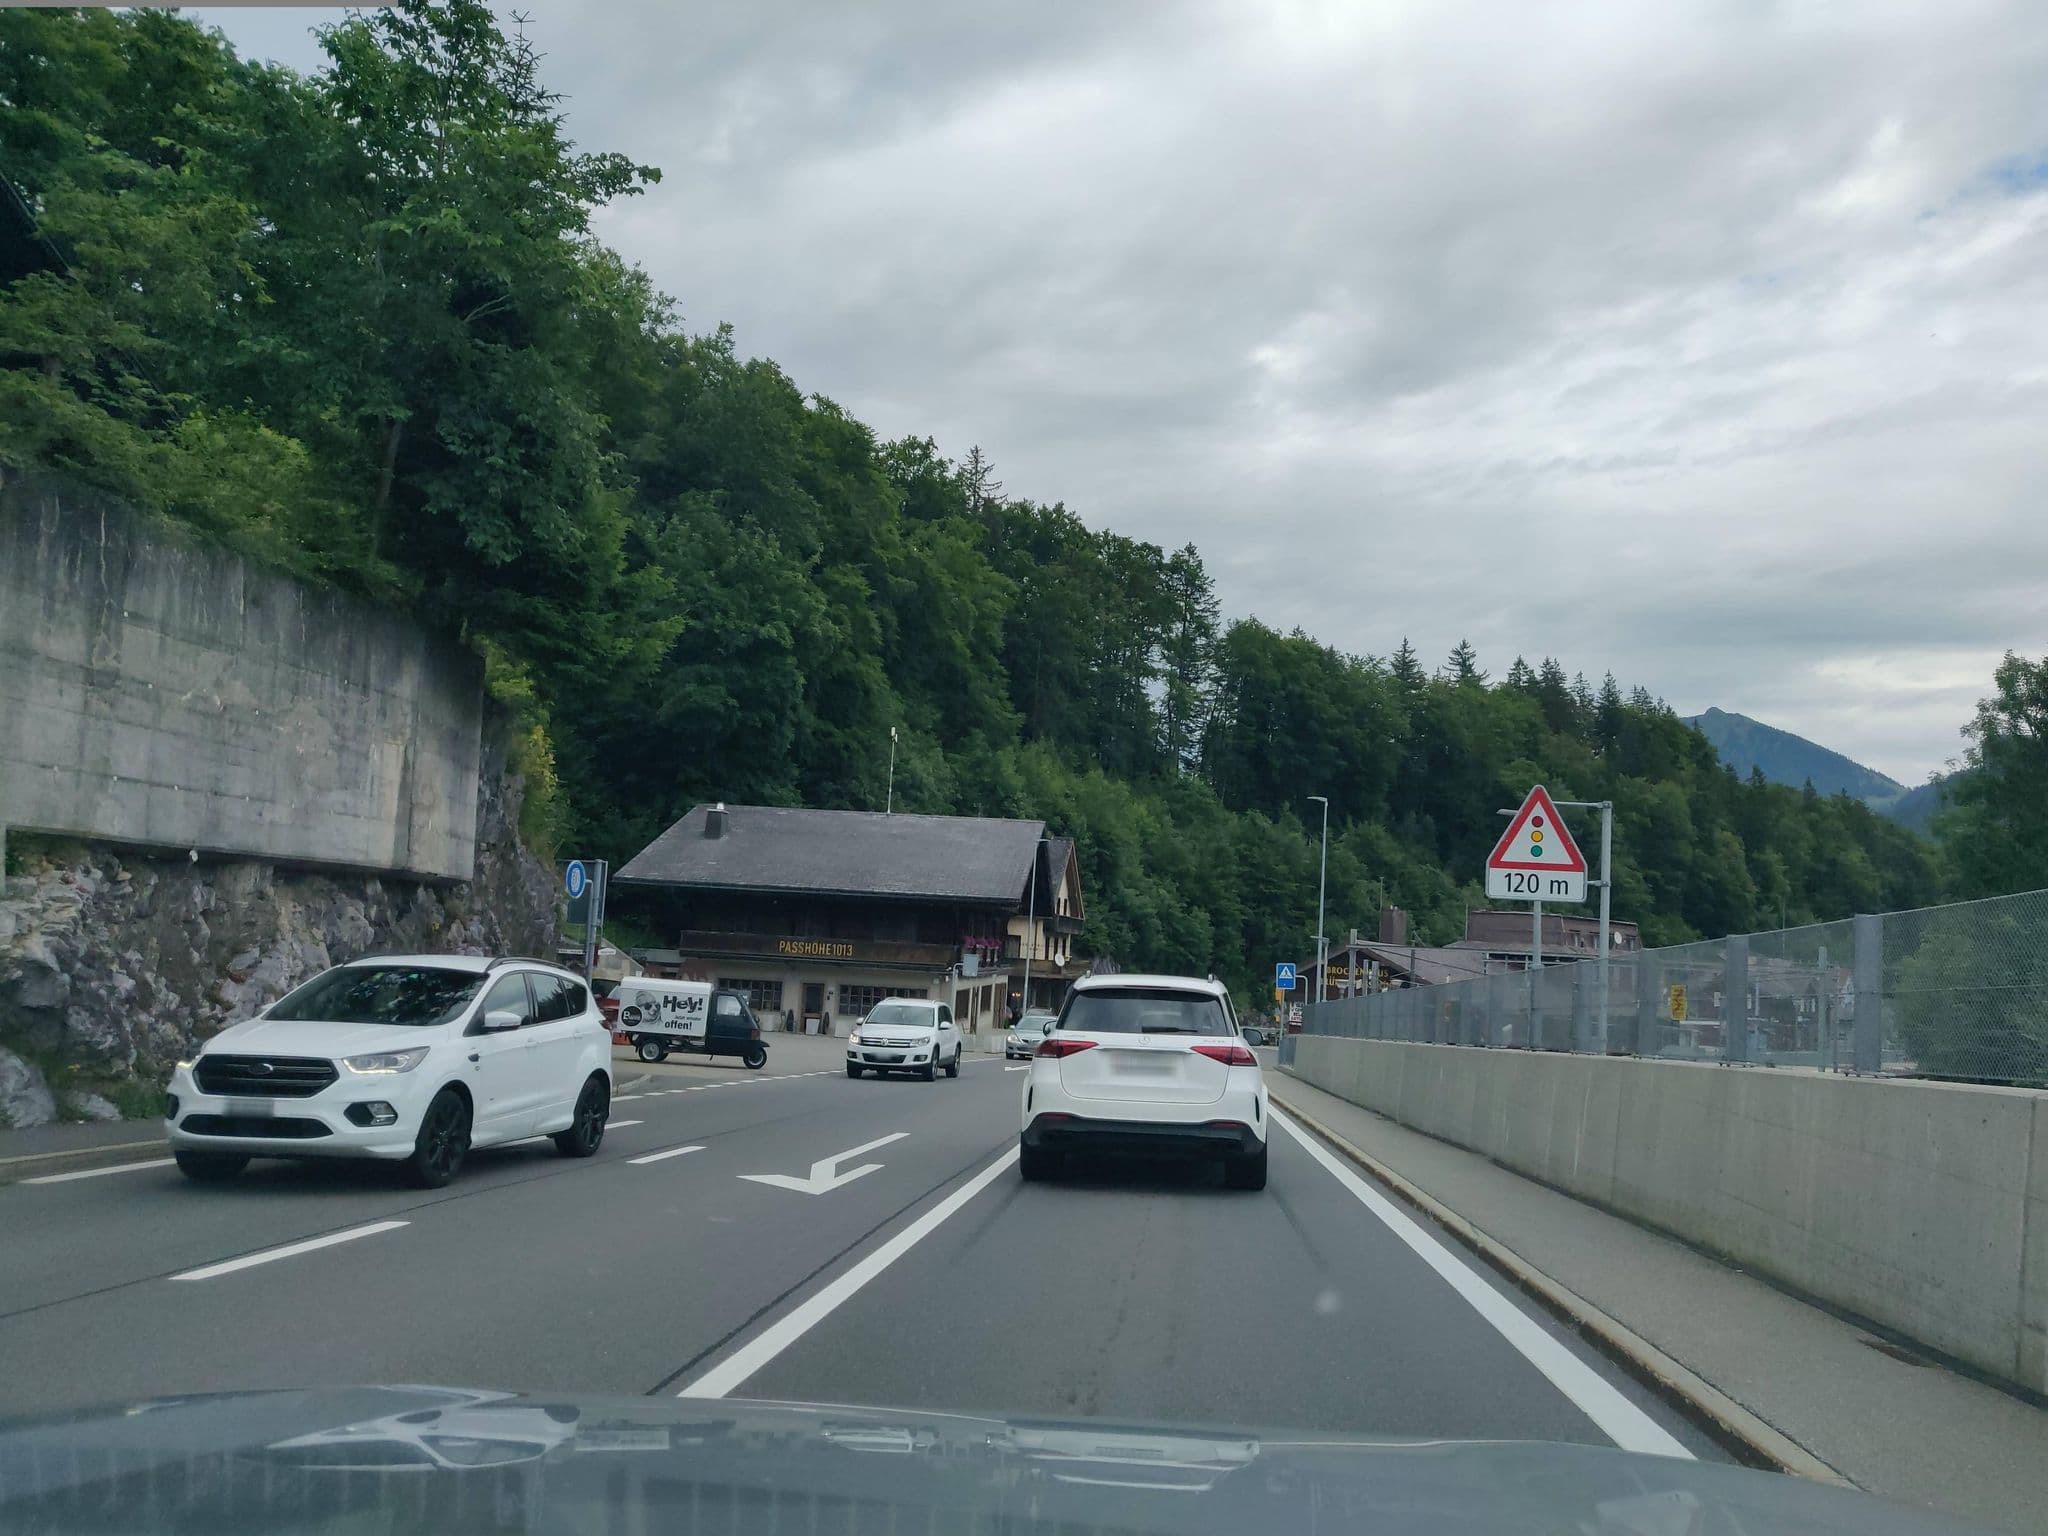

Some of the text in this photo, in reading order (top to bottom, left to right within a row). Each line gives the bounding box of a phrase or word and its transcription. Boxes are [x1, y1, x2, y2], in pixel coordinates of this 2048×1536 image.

[1504, 873, 1569, 895] 120 m
[663, 995, 703, 1013] Hey!
[664, 1020, 693, 1030] offen!
